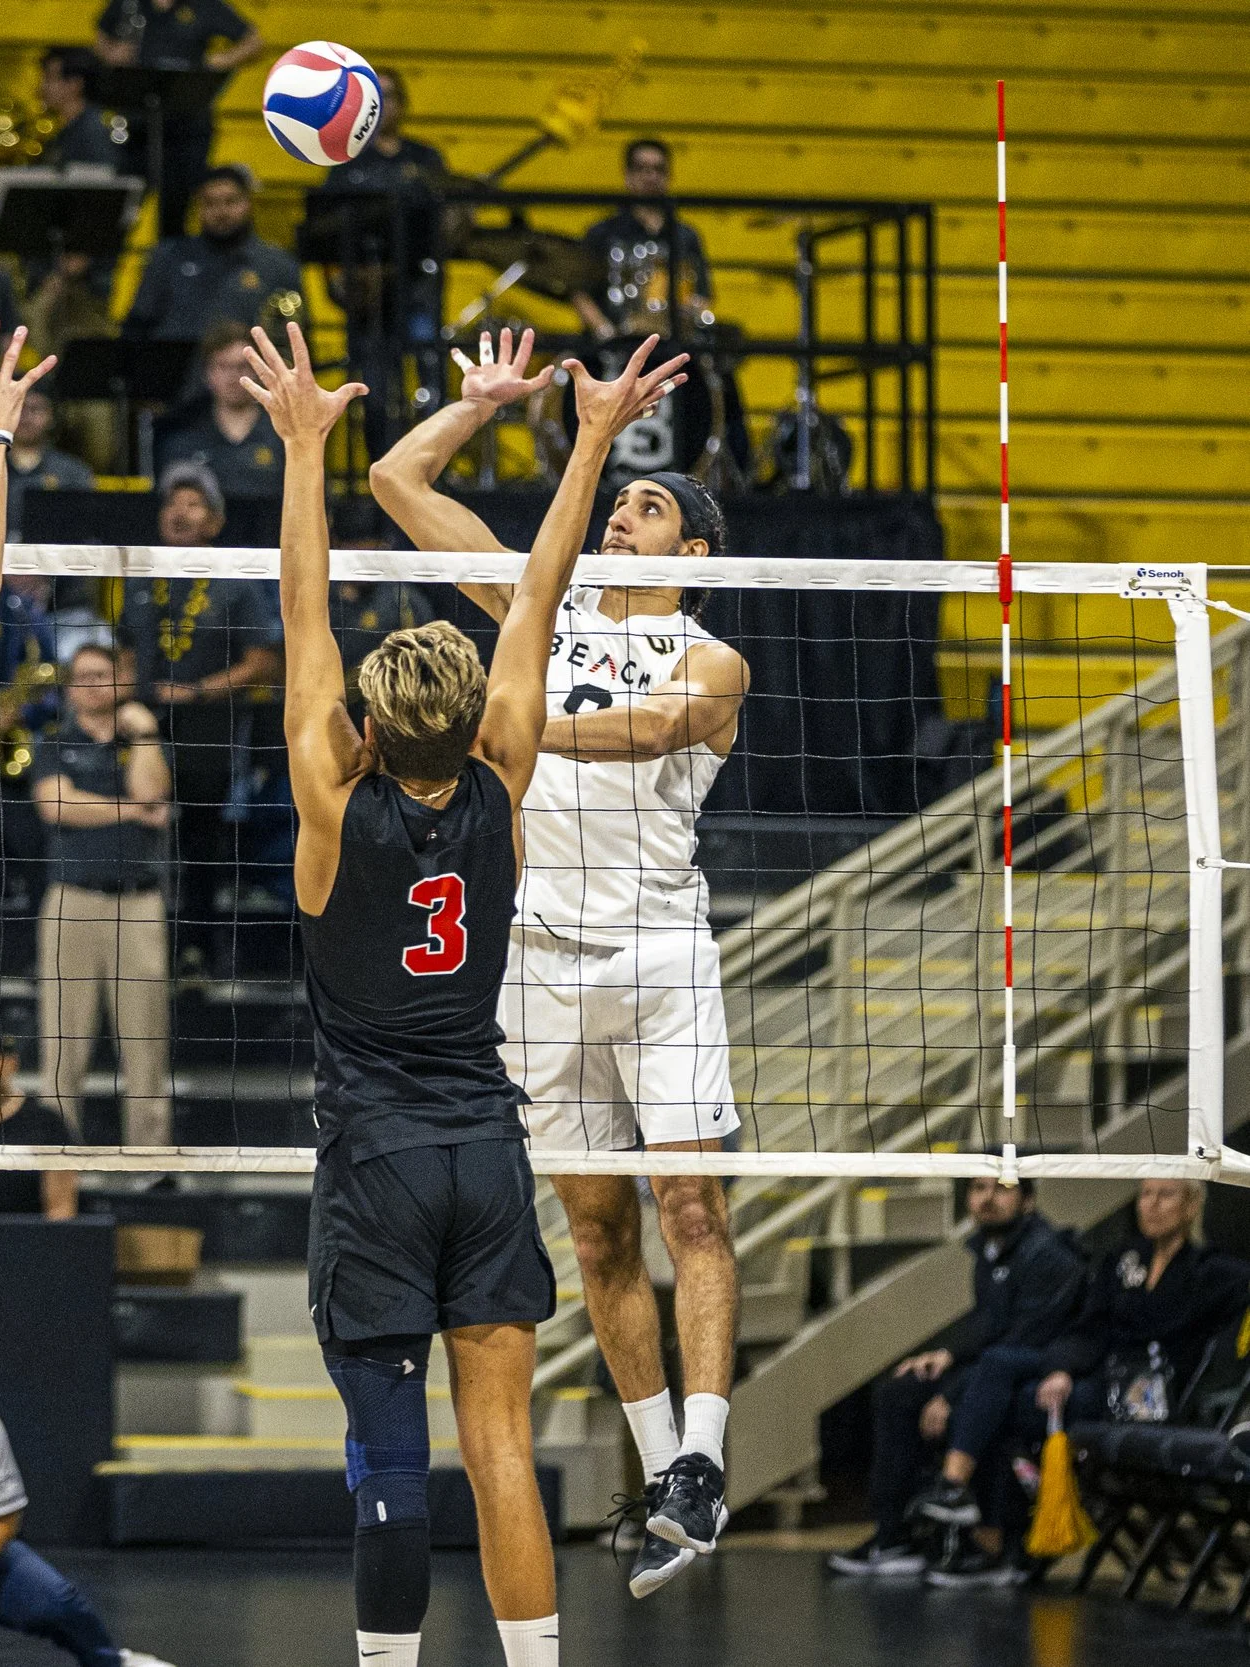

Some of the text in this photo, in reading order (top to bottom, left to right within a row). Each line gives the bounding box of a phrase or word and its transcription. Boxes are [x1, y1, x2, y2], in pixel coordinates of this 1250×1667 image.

[354, 99, 378, 141] NCAA
[1148, 569, 1184, 578] Senoh
[402, 872, 468, 976] 3
